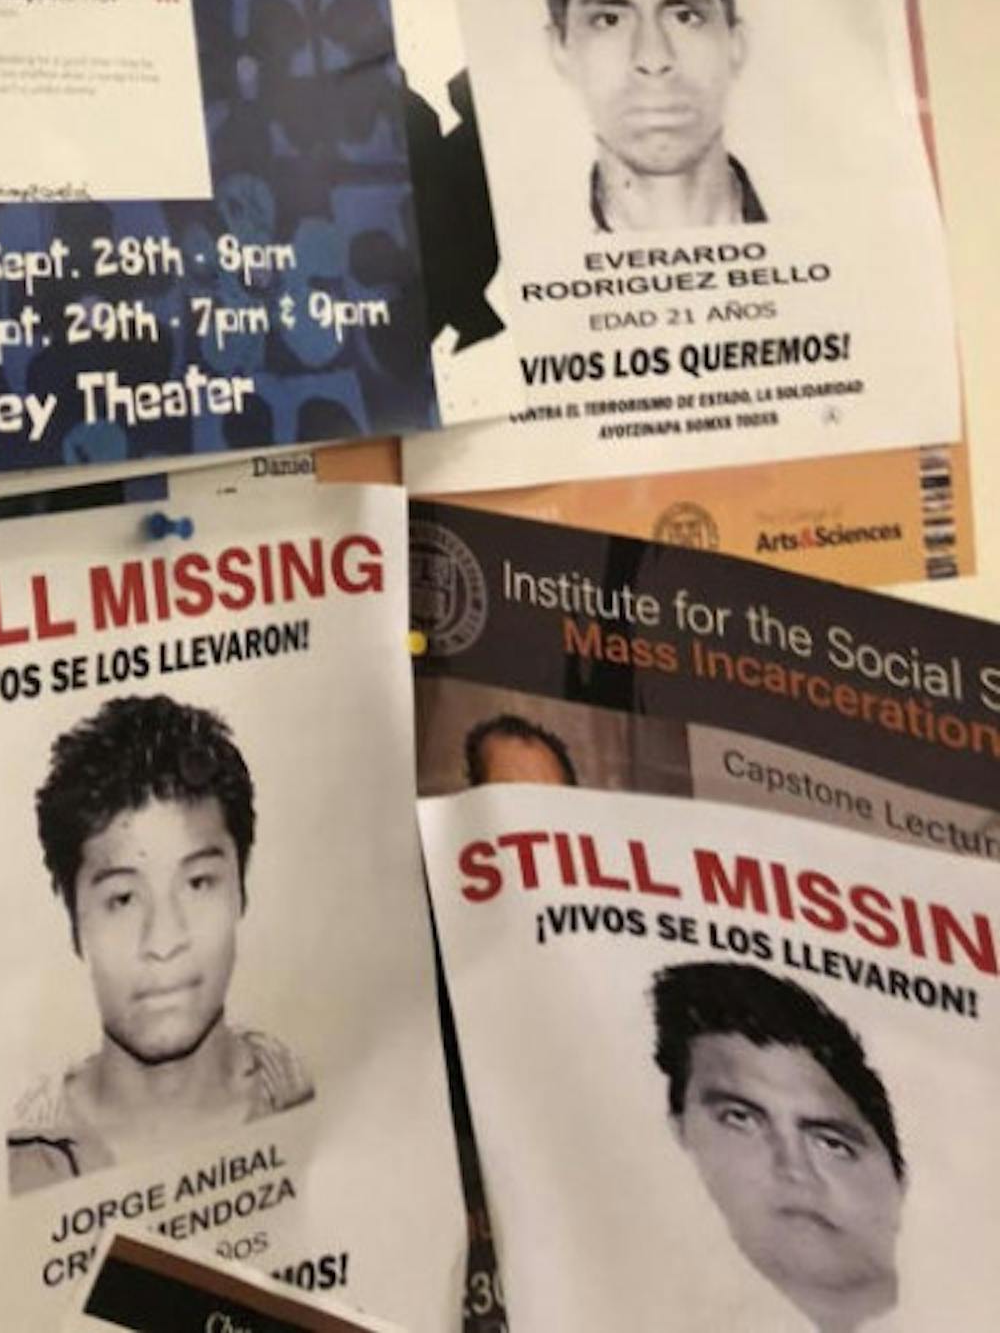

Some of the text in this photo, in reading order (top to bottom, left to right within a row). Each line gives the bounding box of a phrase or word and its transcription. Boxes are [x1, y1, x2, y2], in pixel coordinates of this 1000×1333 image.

[91, 235, 185, 278] 28th
[216, 233, 297, 287] 8pm
[521, 264, 832, 302] RODRIGUEZ BELLO
[583, 240, 768, 272] EVERARDO
[62, 300, 160, 348] 29th
[190, 296, 270, 352] 7pm
[308, 290, 391, 344] 9pm
[589, 299, 779, 332] EDAD 21 AÑOS
[613, 348, 671, 378] LOS
[679, 332, 852, 377] QUEREMOS!
[75, 363, 258, 427] Theater
[585, 396, 673, 417] TERRORISMO
[676, 394, 696, 409] DE
[756, 387, 774, 403] LA
[776, 379, 865, 400] SOLIDARIDAD
[598, 419, 682, 441] AYOTZINAPA
[756, 522, 903, 554] Arts&Sciences
[89, 533, 386, 633] MISSING
[51, 656, 89, 694] SE
[96, 645, 151, 687] LOS
[158, 619, 312, 675] LLEVARON!
[502, 560, 663, 627] Institute
[673, 587, 731, 637] for
[746, 604, 814, 659] the
[825, 627, 963, 702] Social
[561, 619, 679, 672] Mass
[722, 747, 876, 821] Capstone
[457, 830, 683, 906] STILL
[535, 902, 979, 1020] ¡VIVOS SE LOS LLEVARON!
[51, 1183, 168, 1244] JORGE
[42, 1244, 98, 1288] CR
